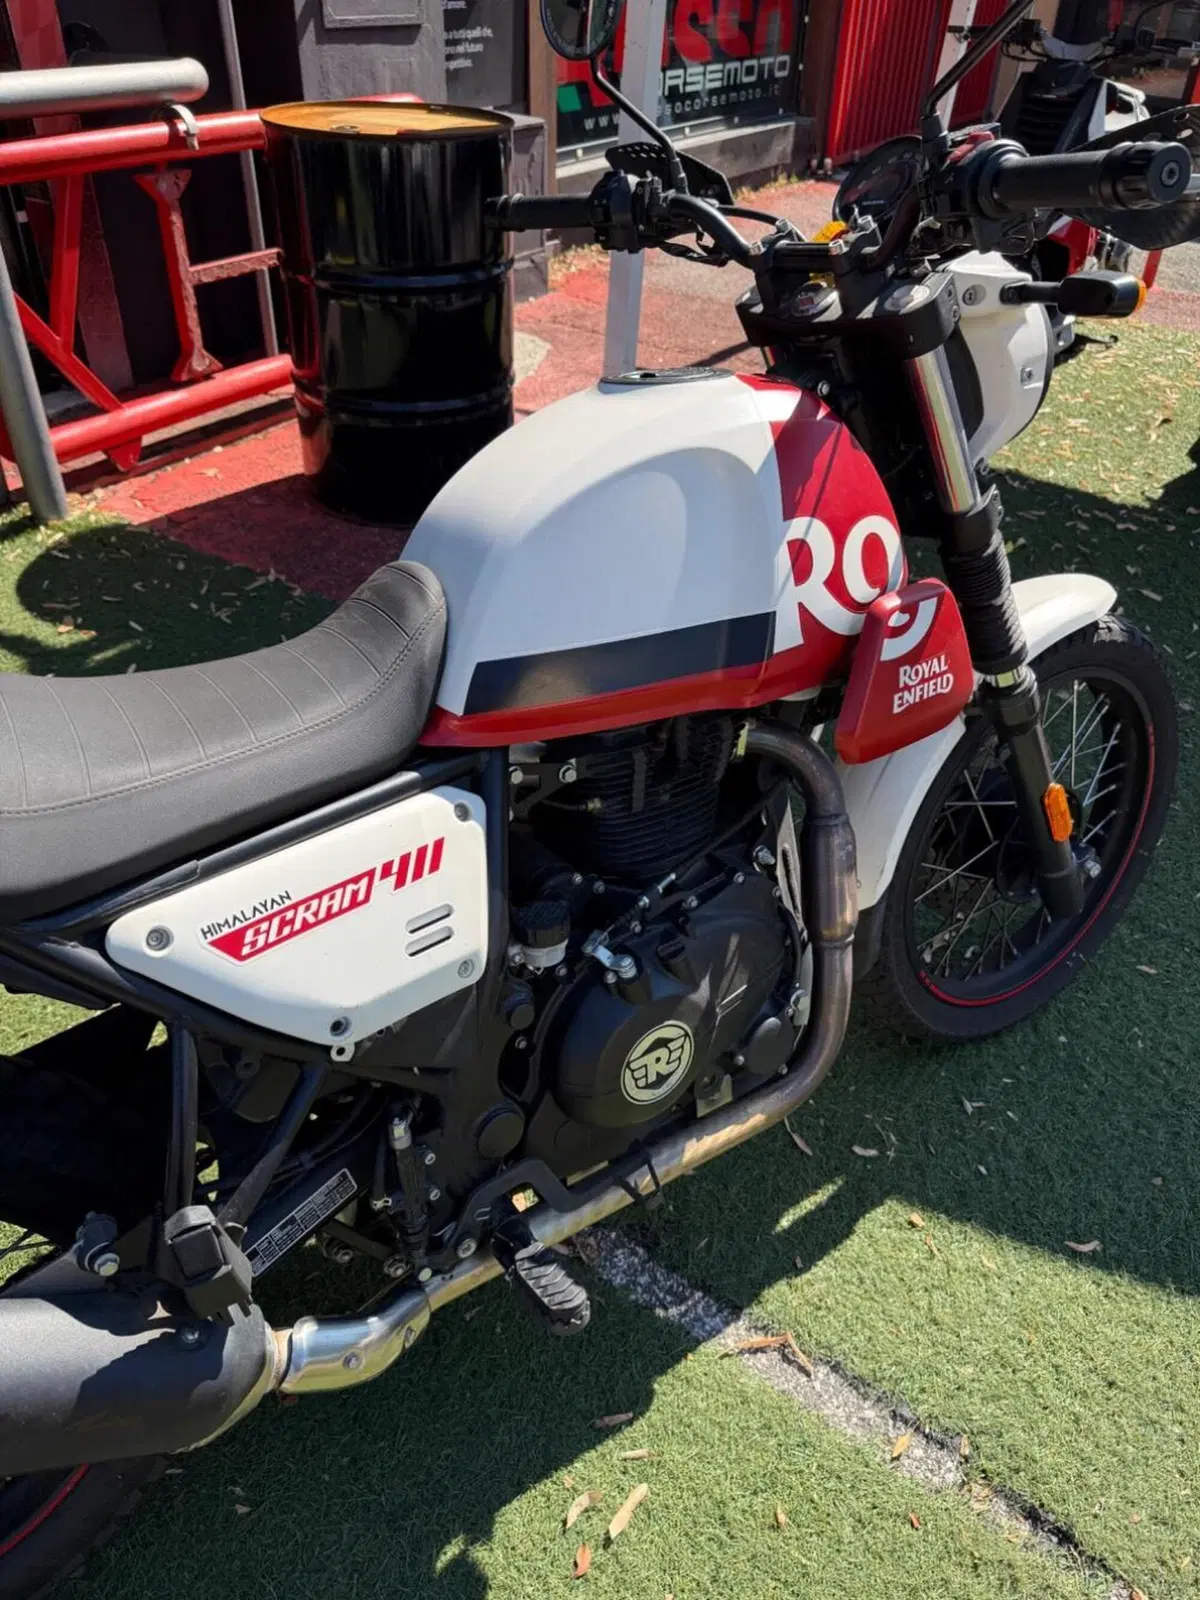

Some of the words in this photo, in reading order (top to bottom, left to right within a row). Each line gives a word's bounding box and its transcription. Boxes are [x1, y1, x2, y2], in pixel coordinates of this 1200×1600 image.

[892, 673, 954, 715] ENFIELD
[899, 655, 948, 688] ROYAL
[200, 890, 292, 940] HIMALAYAN
[241, 876, 370, 956] SCRAM
[379, 836, 445, 892] 411
